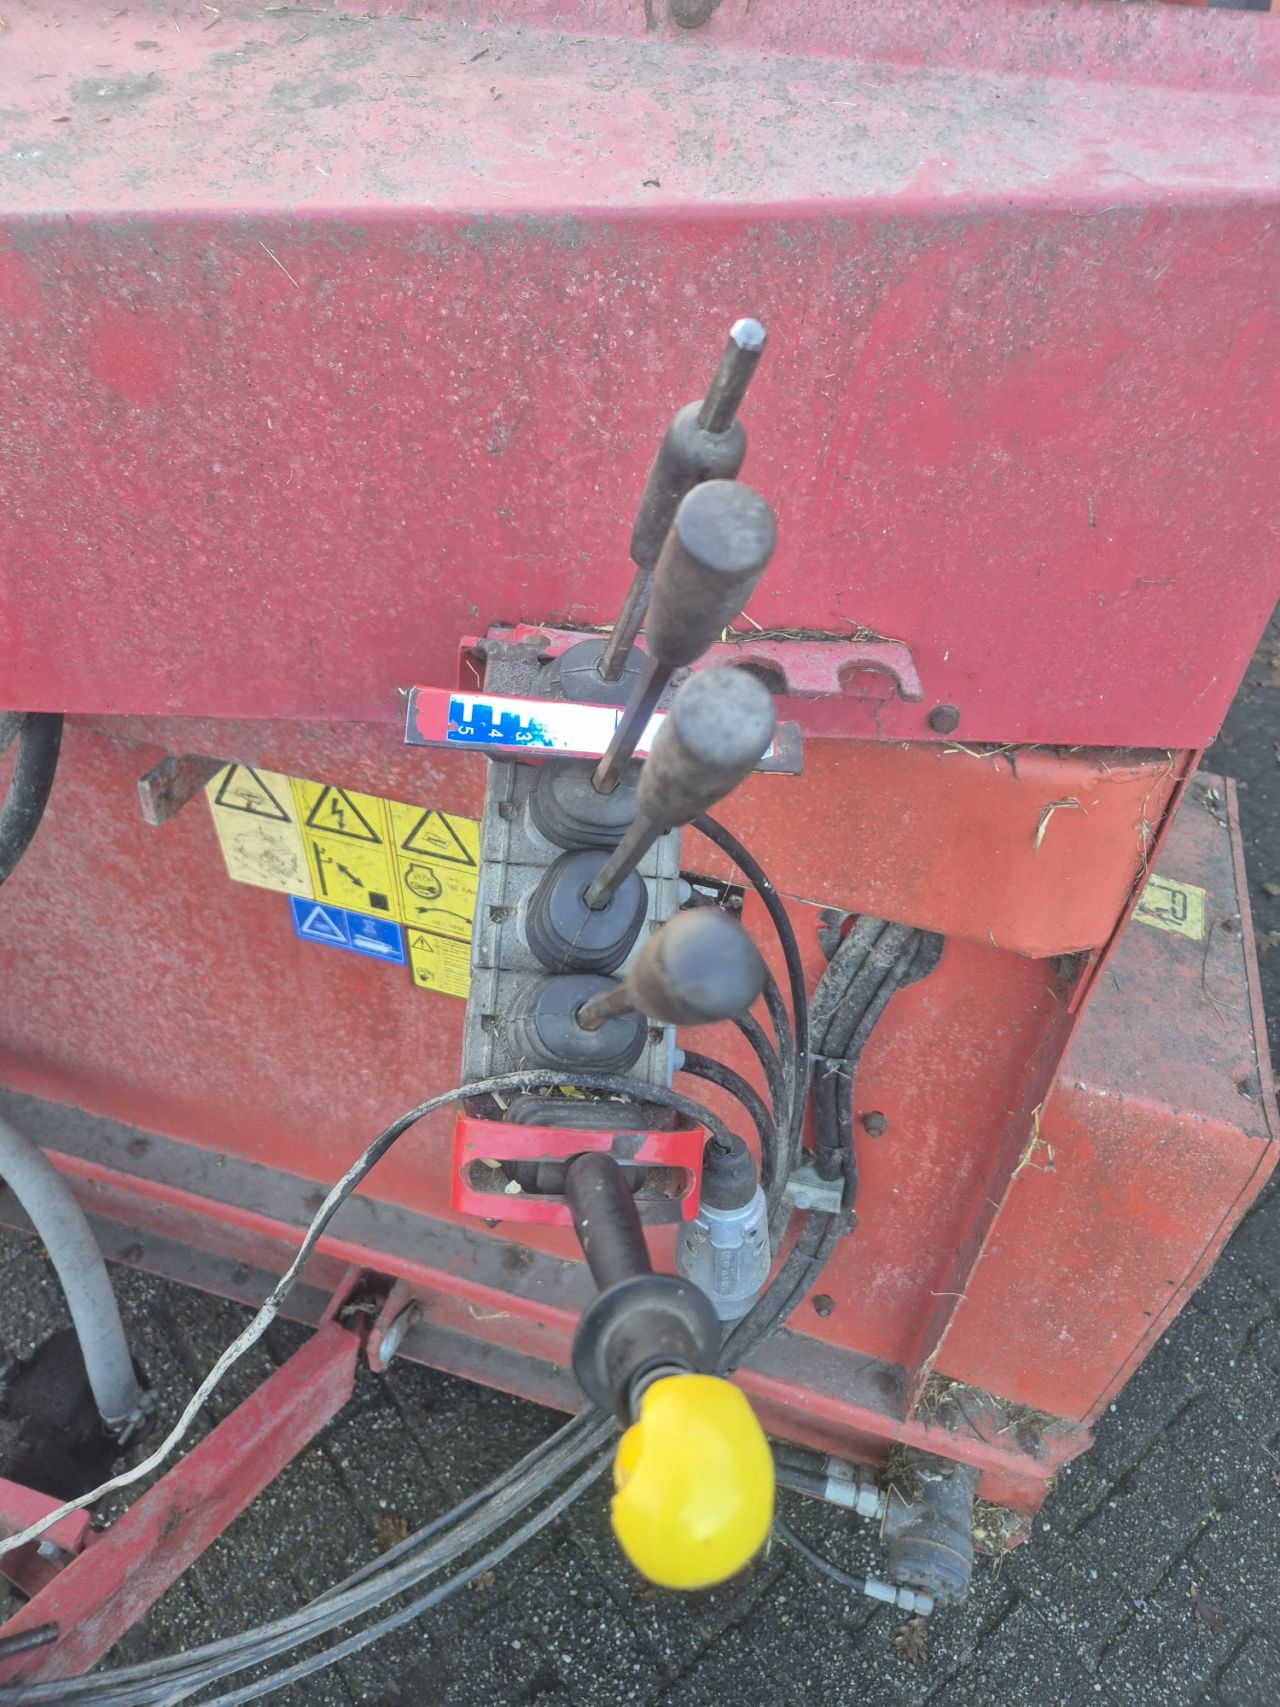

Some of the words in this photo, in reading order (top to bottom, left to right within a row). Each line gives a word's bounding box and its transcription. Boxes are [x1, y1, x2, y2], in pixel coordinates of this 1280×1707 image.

[458, 725, 474, 735] 5
[488, 728, 504, 738] 4
[515, 731, 533, 741] 3
